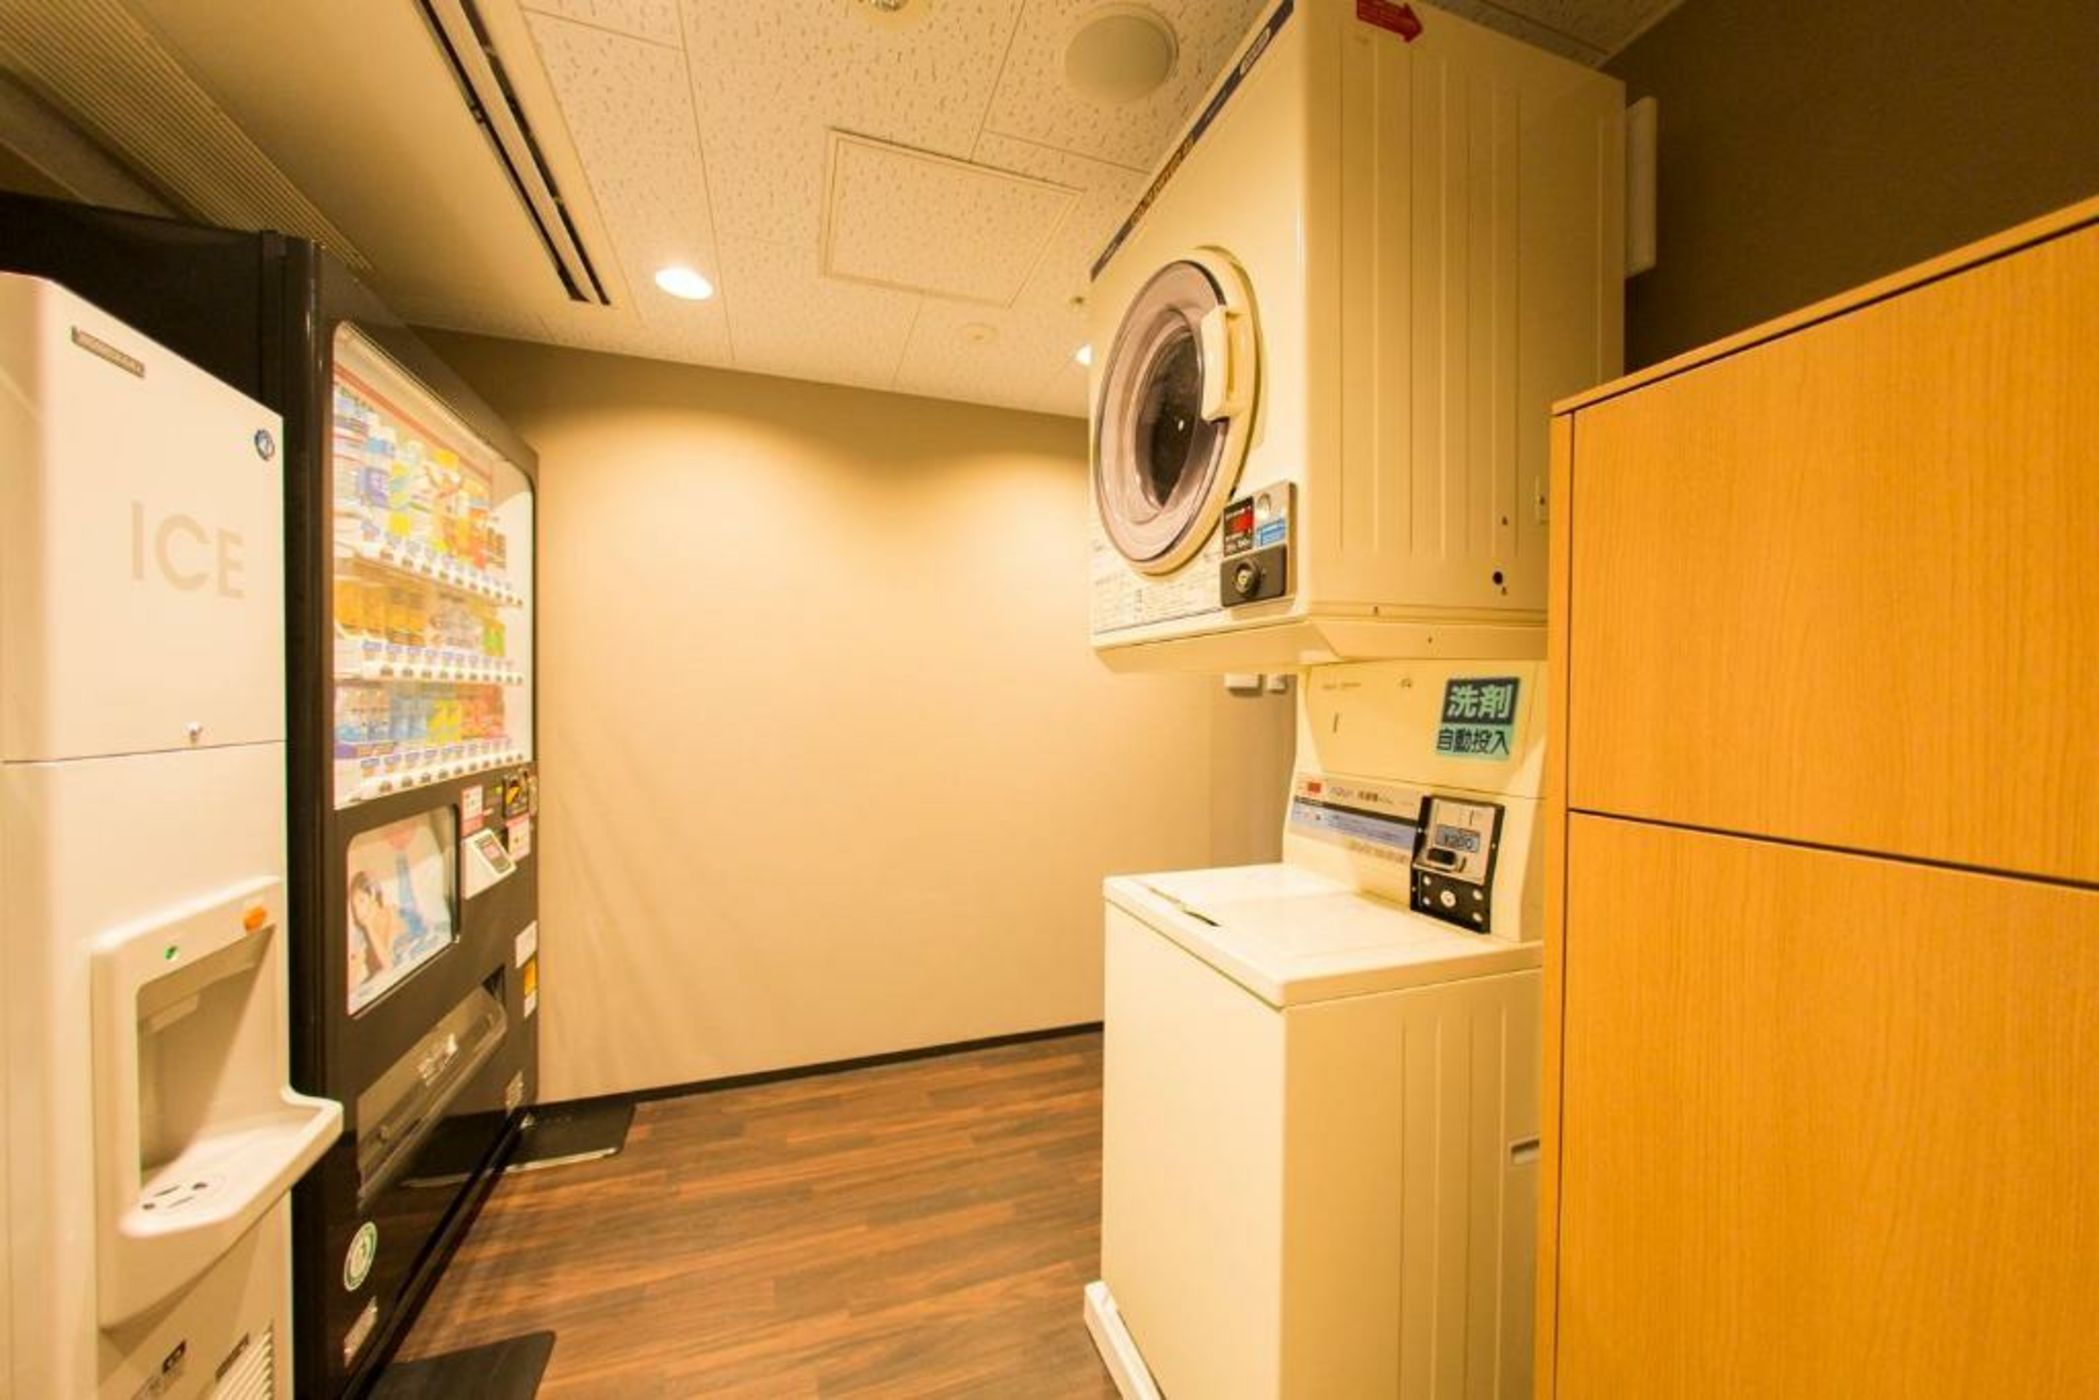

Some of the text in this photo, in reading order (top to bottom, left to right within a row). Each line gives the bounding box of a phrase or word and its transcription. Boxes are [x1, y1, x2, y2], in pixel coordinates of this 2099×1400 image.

[131, 499, 245, 599] ICE
[1446, 683, 1514, 719] 洗剤
[1436, 727, 1510, 755] 自動投入
